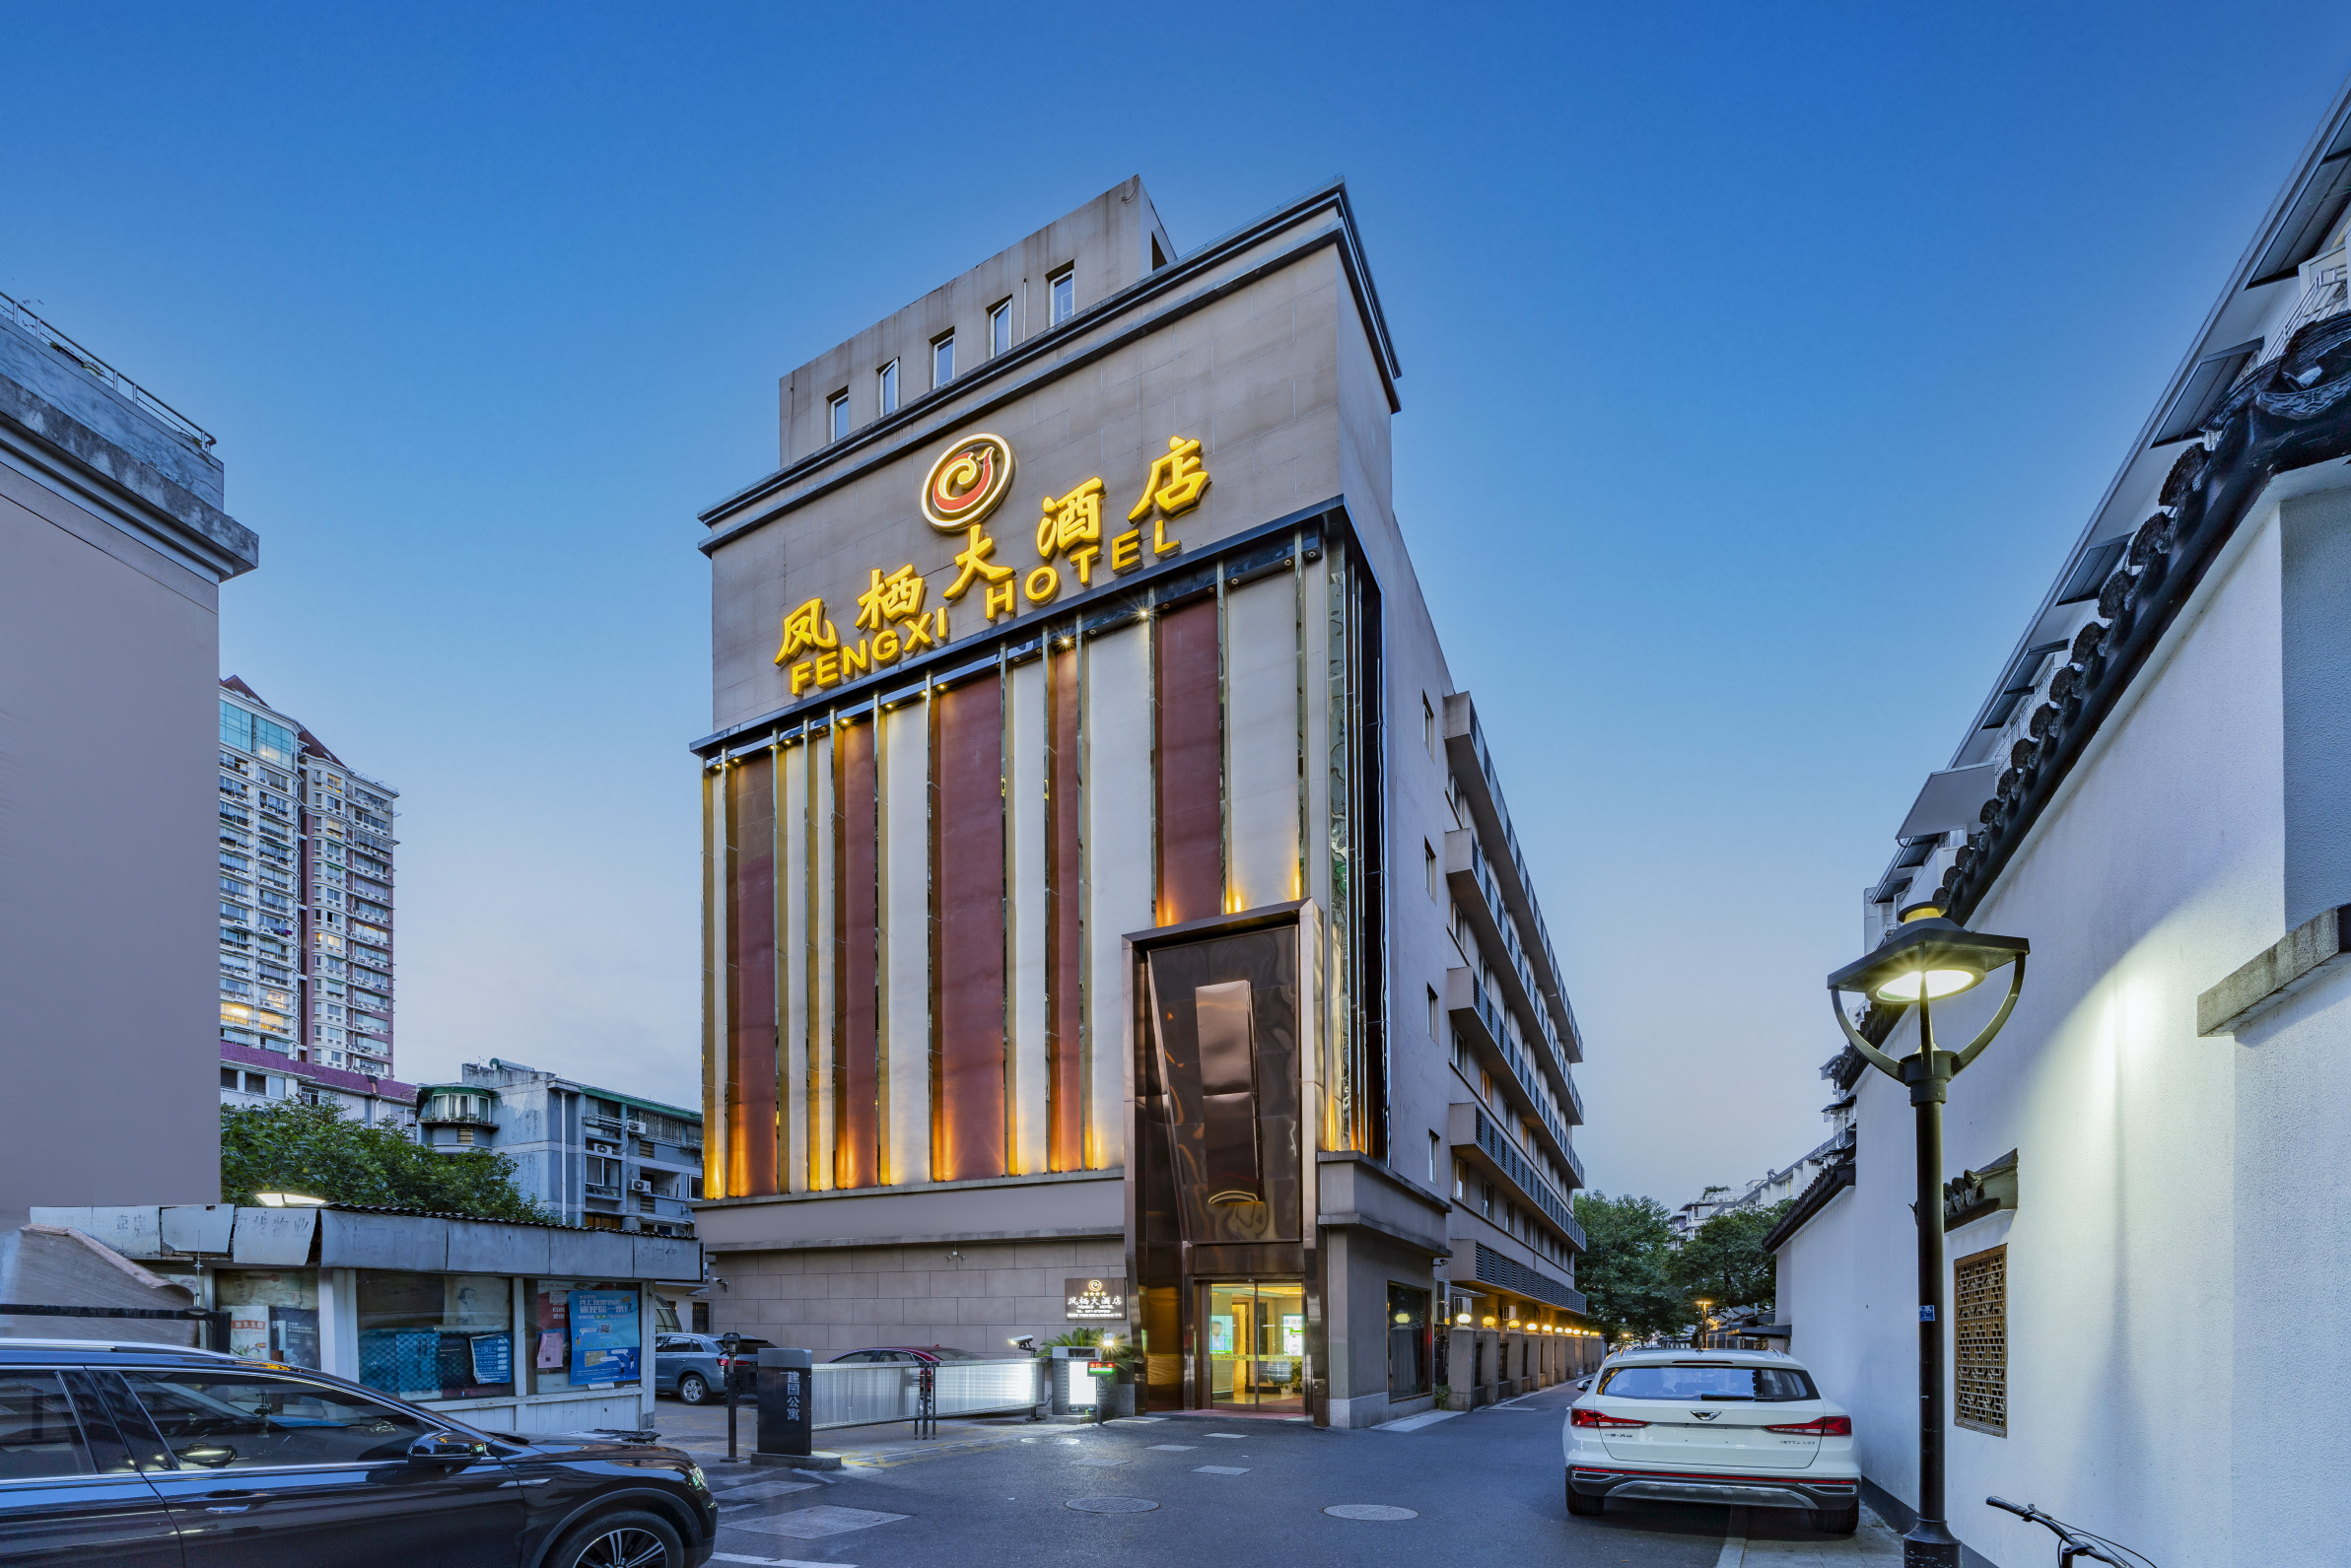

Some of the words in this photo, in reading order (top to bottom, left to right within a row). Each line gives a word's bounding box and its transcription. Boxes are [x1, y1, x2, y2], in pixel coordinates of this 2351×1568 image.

[774, 436, 1212, 667] 凤栖大酒店
[791, 606, 948, 697] FENGXI
[986, 519, 1182, 623] HOTEL
[1068, 1296, 1122, 1305] 凤栖大酒店
[787, 1371, 799, 1421] 建国公寓
